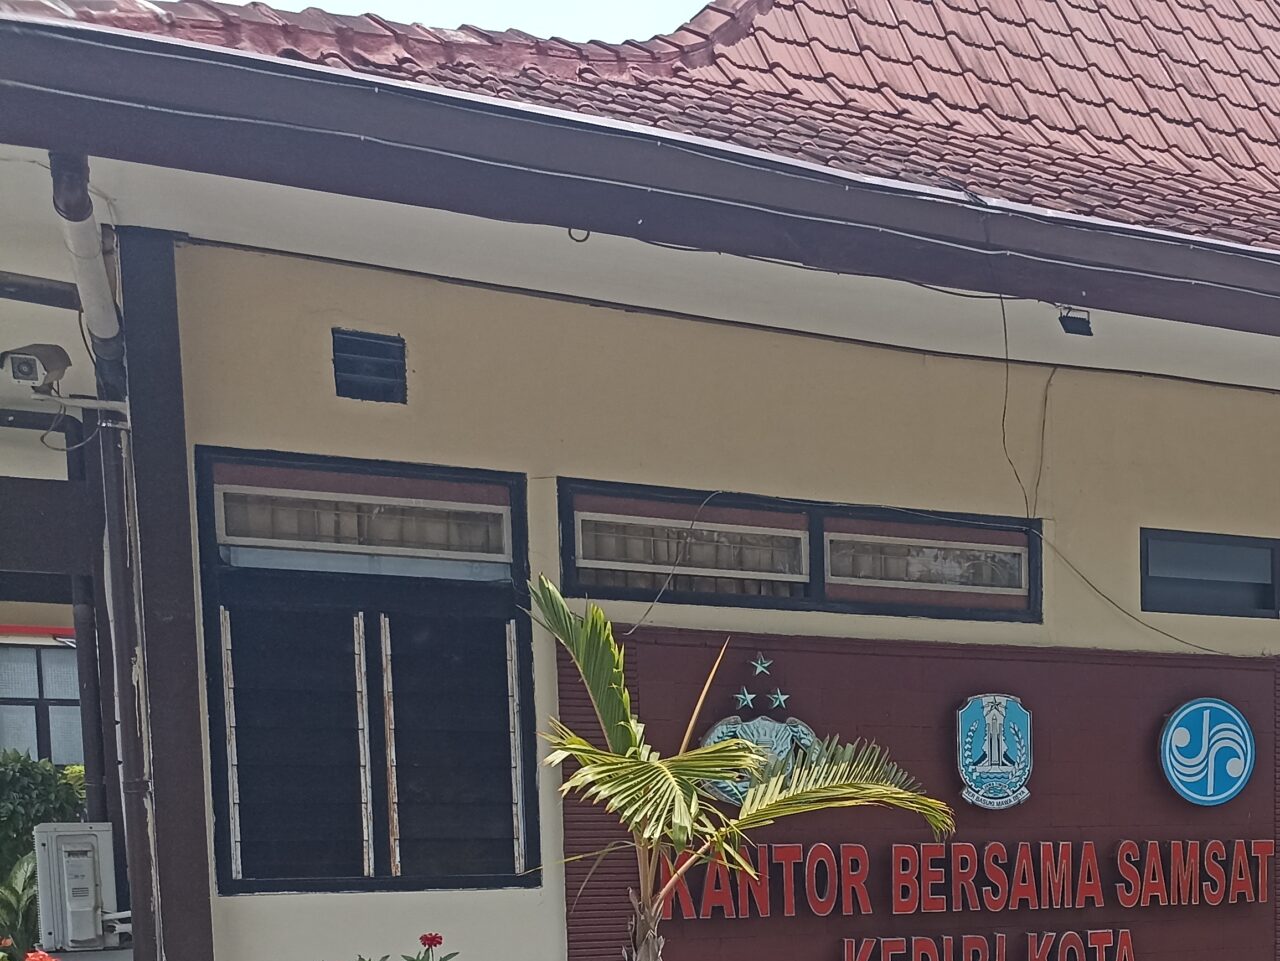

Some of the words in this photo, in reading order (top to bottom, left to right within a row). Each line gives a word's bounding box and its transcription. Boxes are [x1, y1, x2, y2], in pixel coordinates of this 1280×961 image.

[659, 842, 873, 920] KANTOR
[891, 841, 1104, 915] BERSAMA
[1115, 839, 1275, 908] SAMSAT
